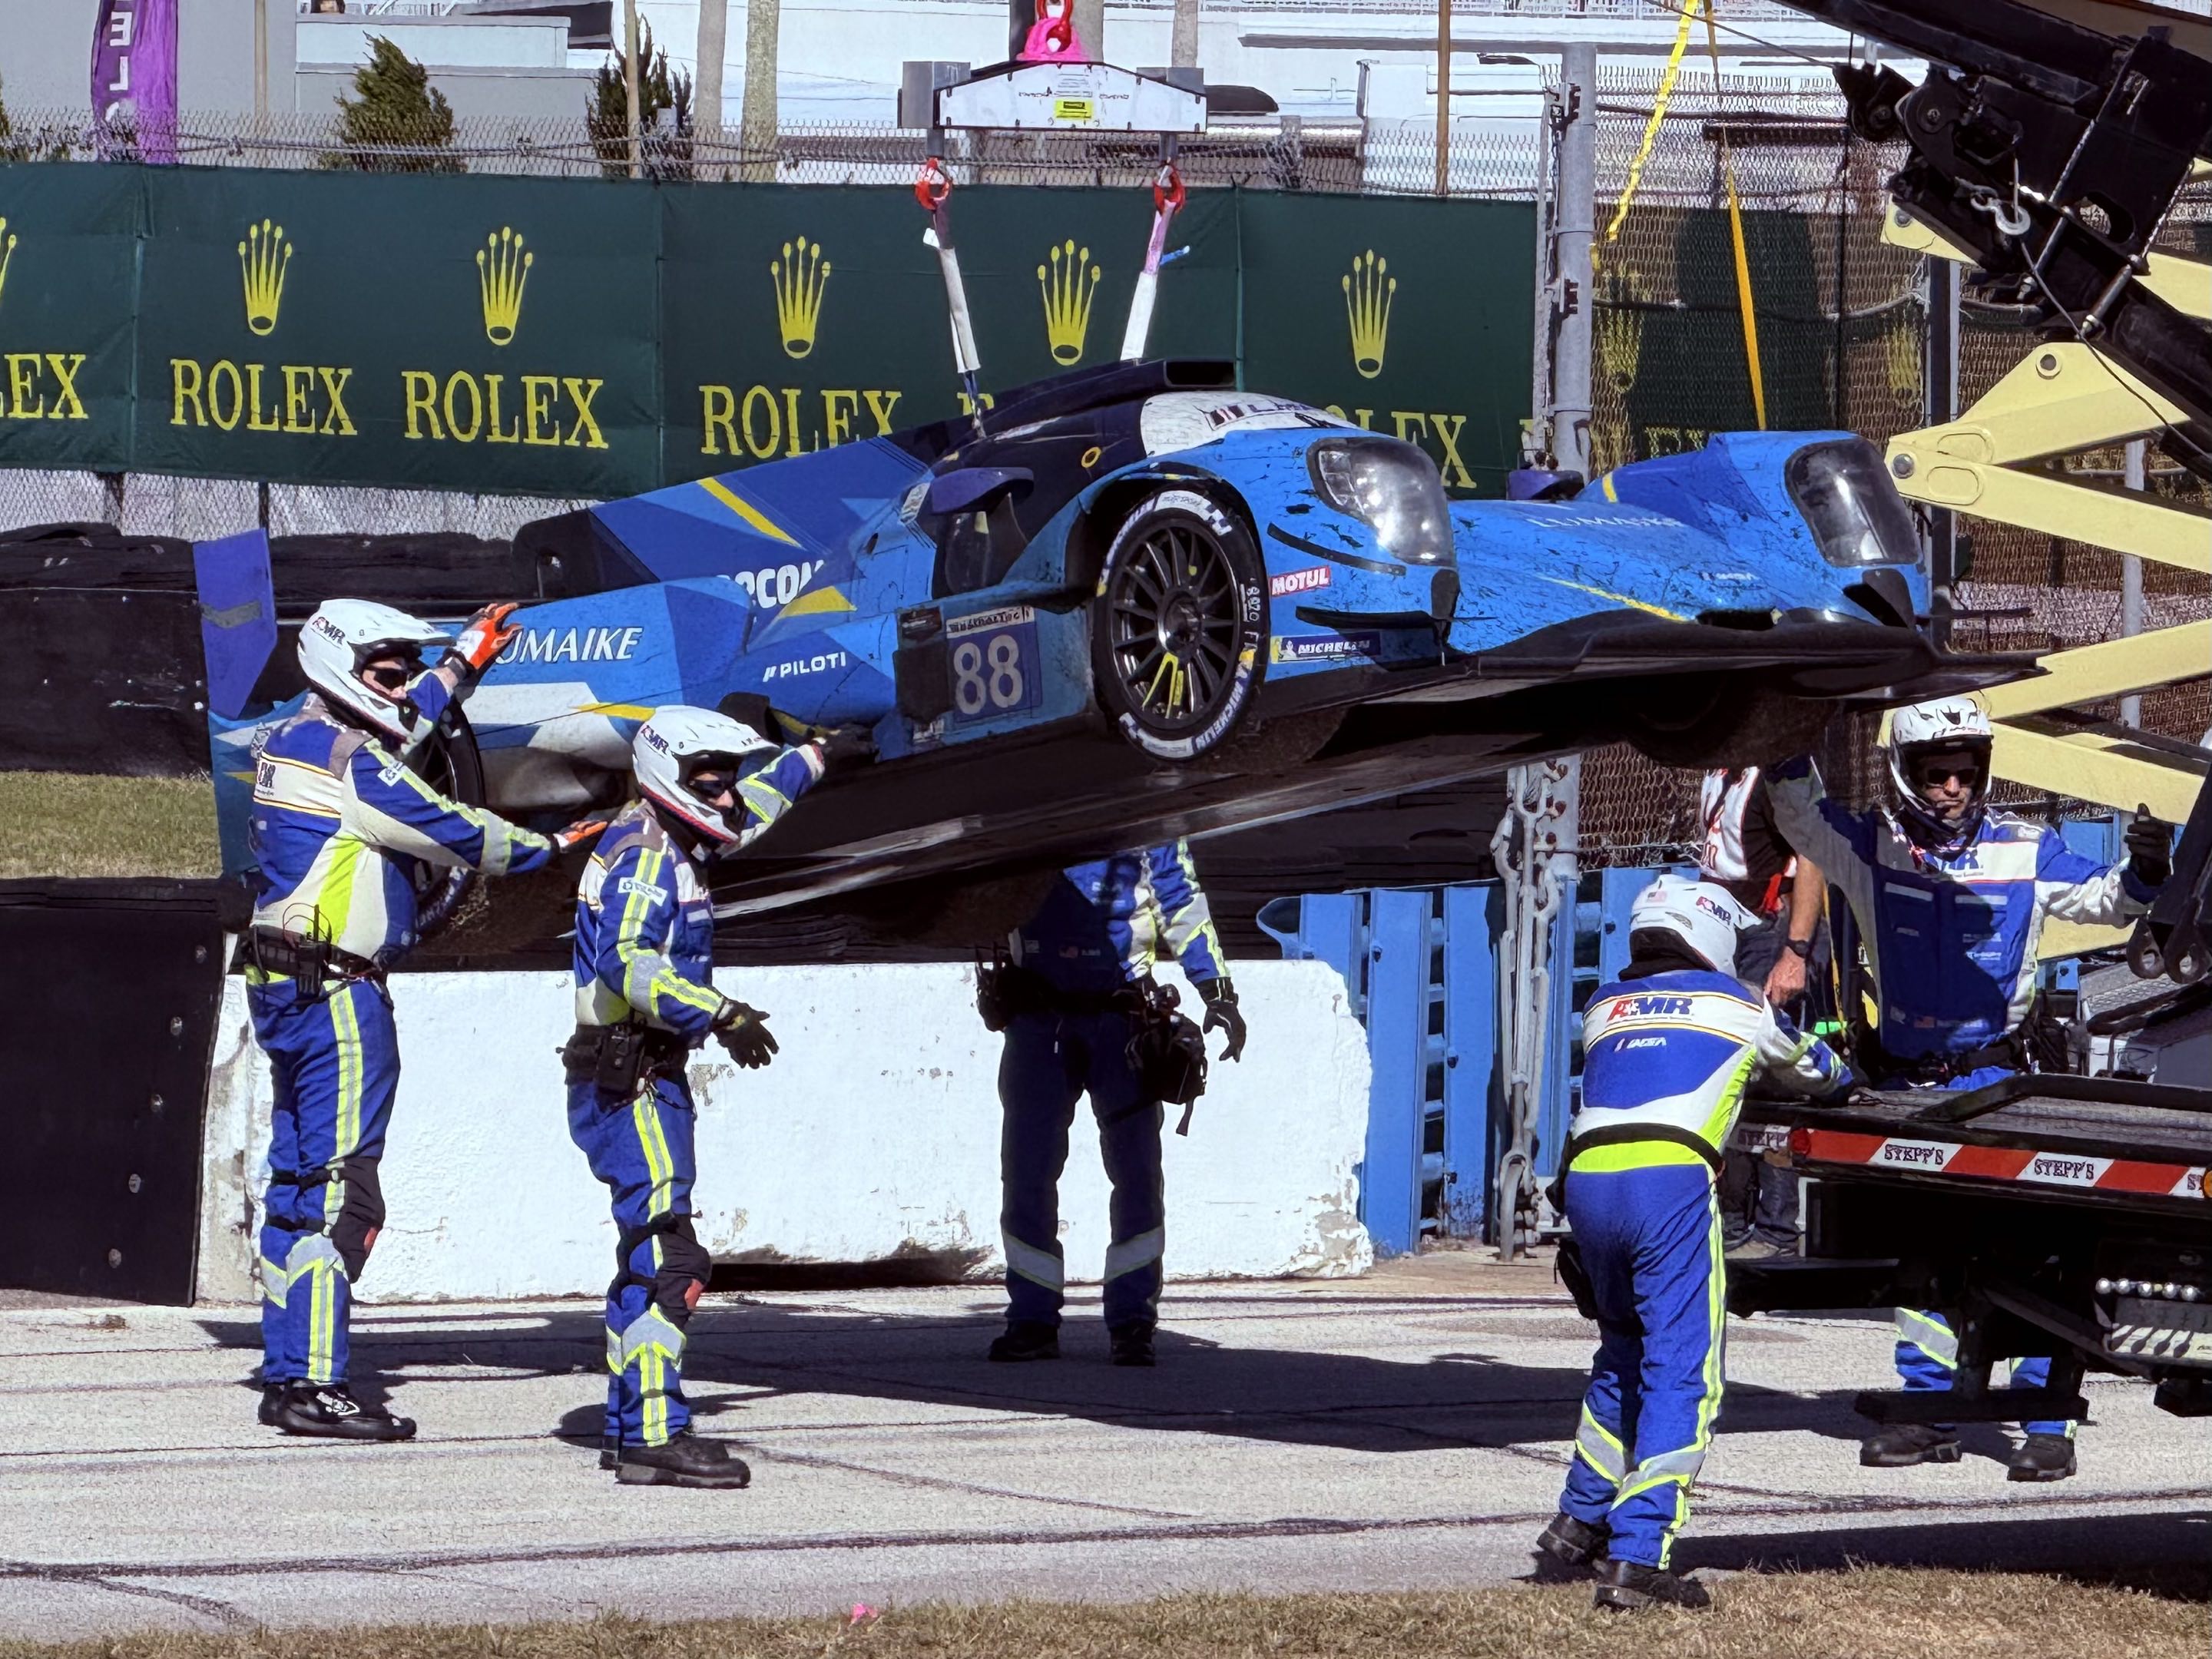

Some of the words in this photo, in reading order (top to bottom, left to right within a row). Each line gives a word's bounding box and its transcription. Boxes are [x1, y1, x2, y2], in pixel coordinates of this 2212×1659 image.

[171, 359, 357, 435] ROLEX
[402, 370, 608, 449] ROLEX
[1271, 568, 1330, 596] MOTUL
[780, 652, 846, 678] PILOTI
[953, 634, 1024, 715] 88
[1884, 1143, 1943, 1165] STEPP'S
[2034, 1158, 2095, 1180] STEPP'S
